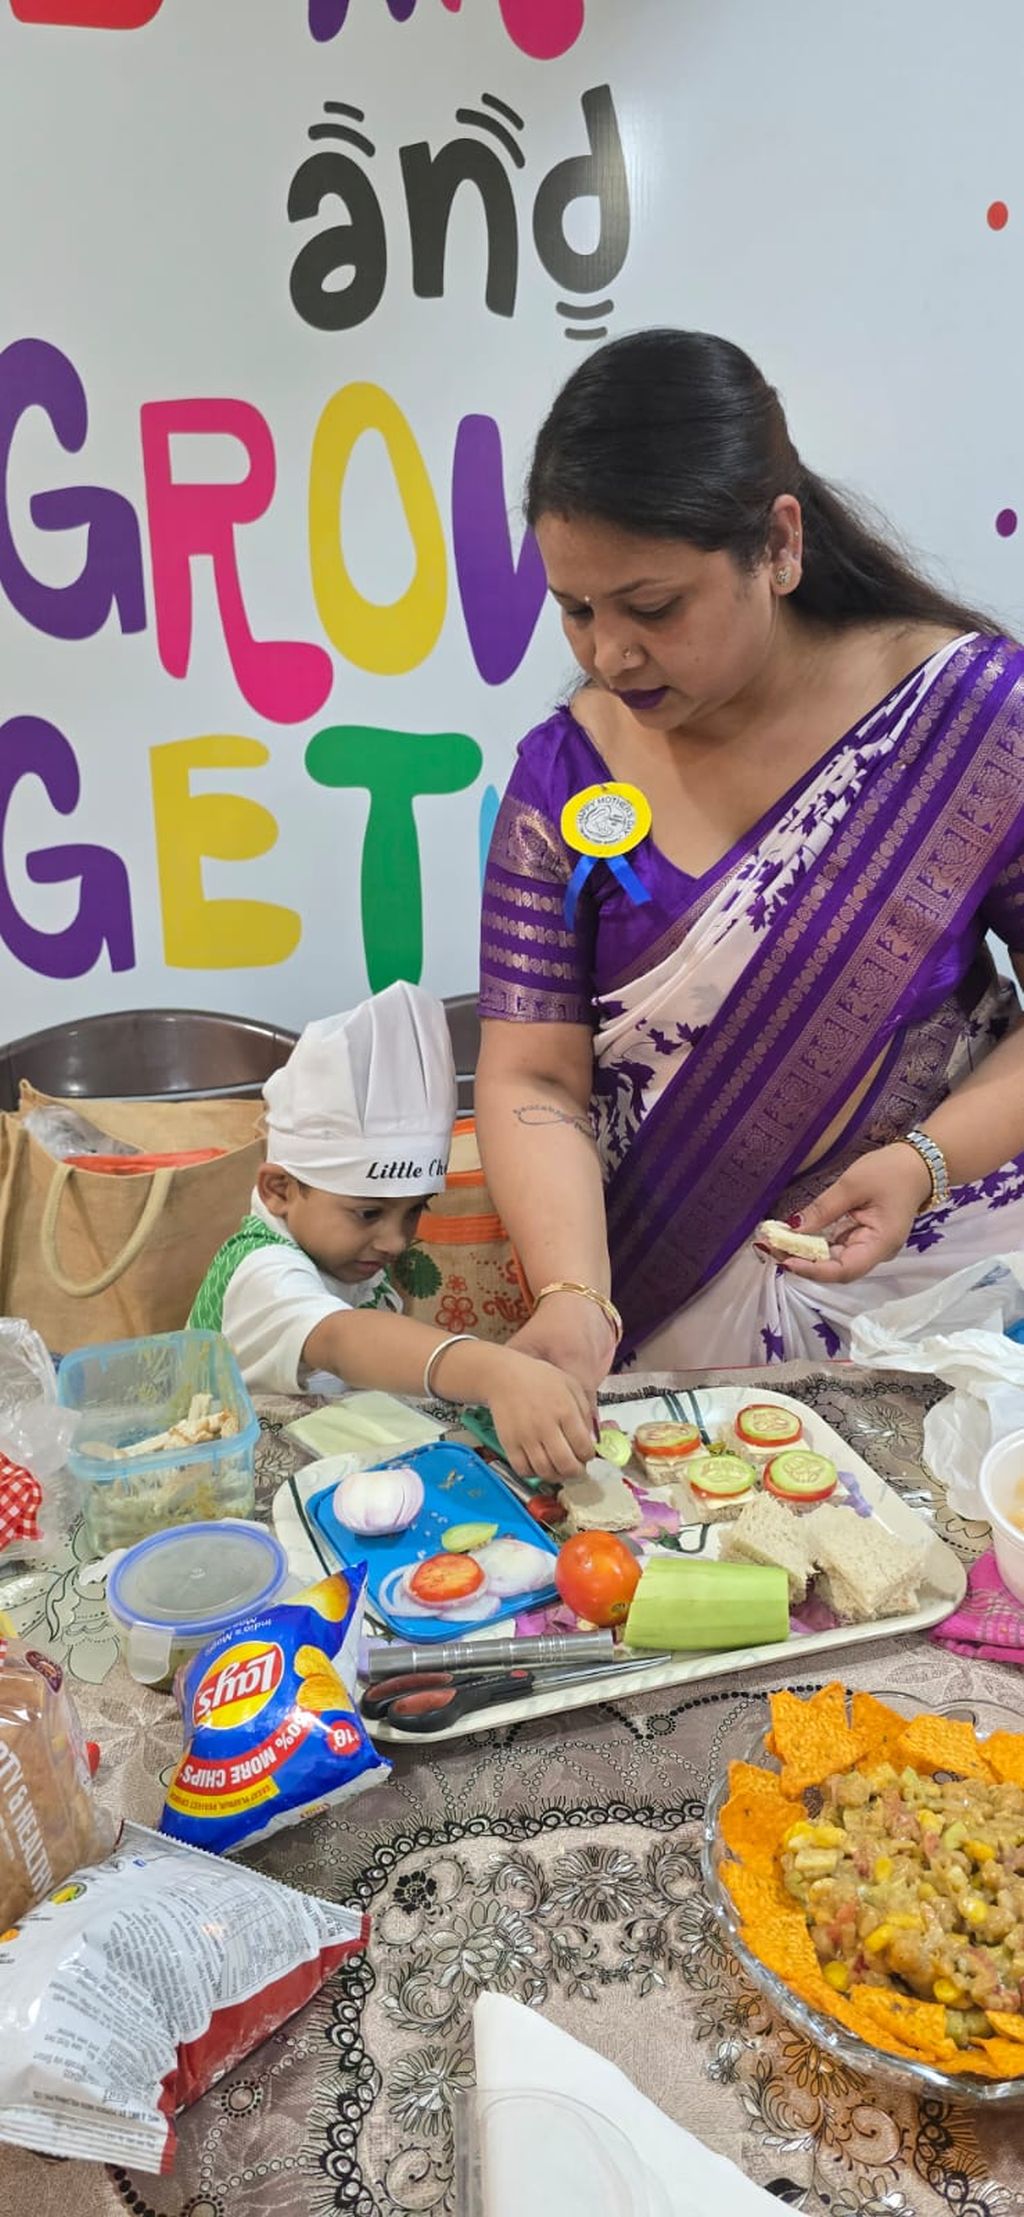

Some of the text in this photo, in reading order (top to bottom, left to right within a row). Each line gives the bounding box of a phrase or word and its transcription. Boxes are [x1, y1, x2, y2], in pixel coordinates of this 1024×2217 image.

[287, 84, 632, 331] and
[0, 715, 506, 993] GET
[366, 1161, 423, 1180] Little
[196, 1650, 276, 1718] Lay's
[230, 1746, 277, 1784] MORE
